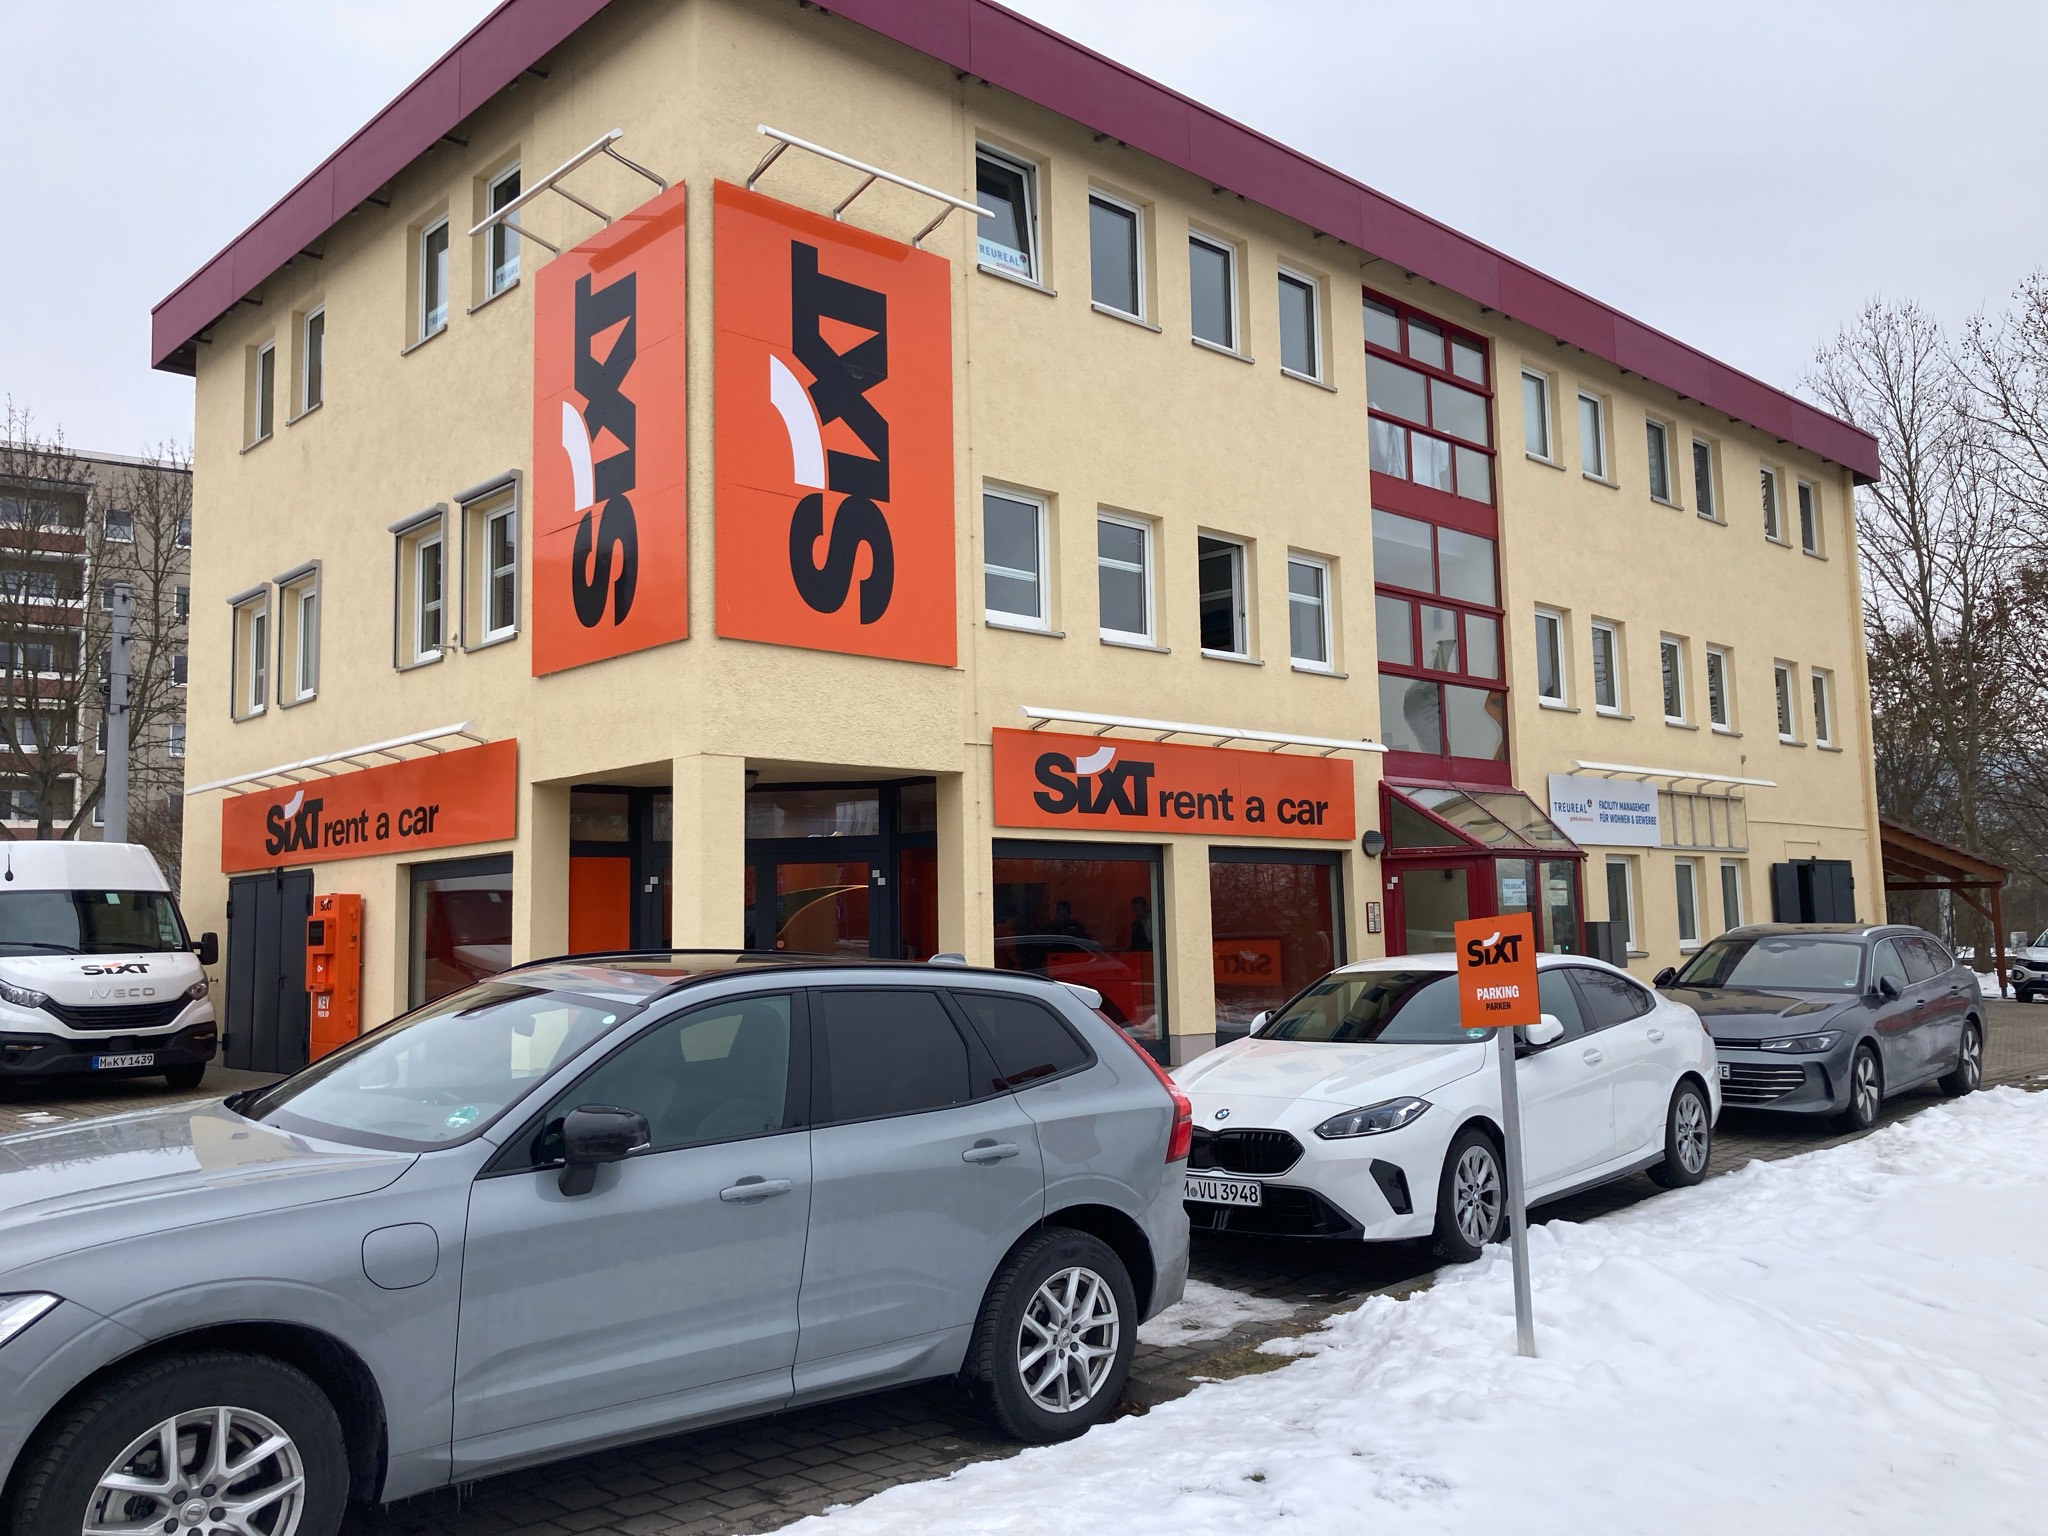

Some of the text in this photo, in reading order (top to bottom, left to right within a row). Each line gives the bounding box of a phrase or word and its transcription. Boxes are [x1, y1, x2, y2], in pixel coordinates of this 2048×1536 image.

[978, 243, 1021, 267] REUREAL
[1159, 788, 1233, 821] rent
[1245, 795, 1265, 823] a
[1277, 798, 1328, 825] car
[1553, 801, 1588, 814] TREUREAL
[1598, 799, 1651, 813] FACILITY MANAGEMENT
[324, 808, 369, 847] rent
[375, 812, 390, 840] a
[398, 804, 439, 837] car
[1599, 811, 1610, 823] FÜR
[1610, 814, 1631, 825] WOHNEN
[1635, 815, 1657, 826] GEWERBE
[89, 987, 156, 999] IVECO
[1476, 985, 1519, 1001] PARKING
[317, 996, 330, 1009] KEY
[1485, 1001, 1512, 1011] PARKEN
[100, 1055, 153, 1067] M KY 1439
[1198, 1181, 1218, 1200] VU
[1220, 1183, 1259, 1203] 3948
